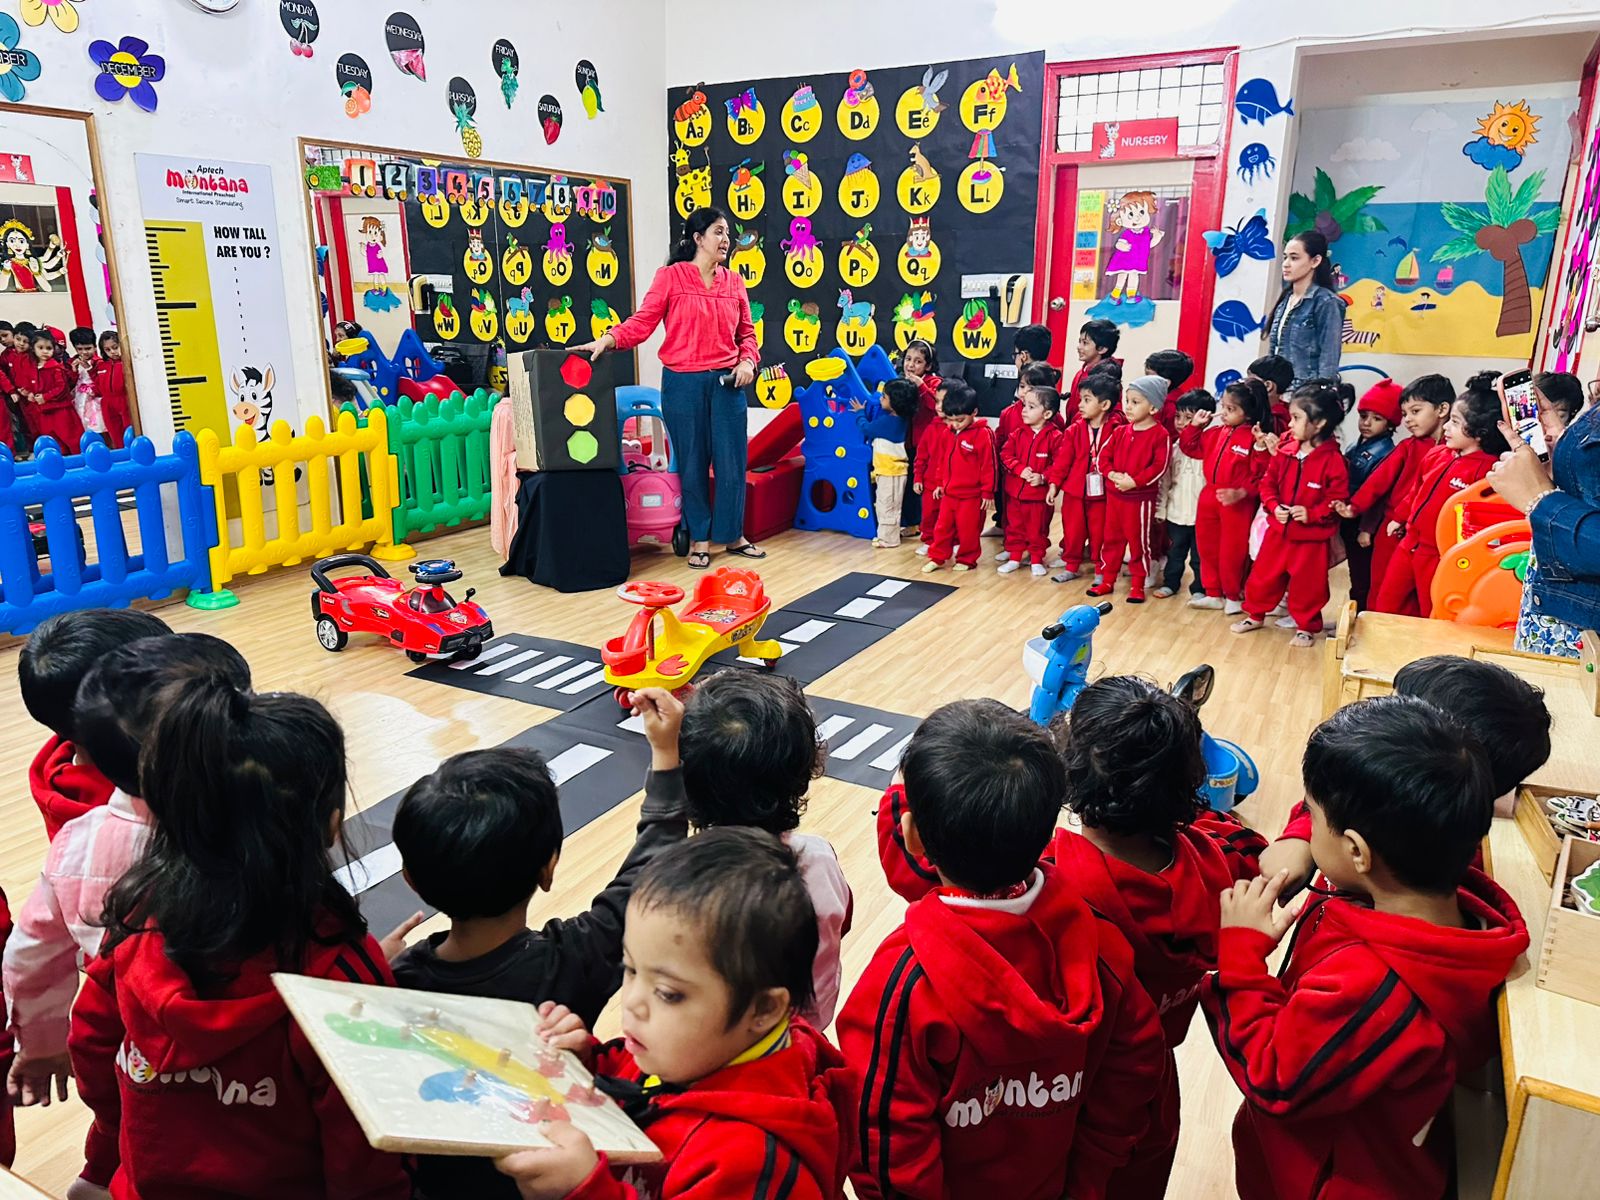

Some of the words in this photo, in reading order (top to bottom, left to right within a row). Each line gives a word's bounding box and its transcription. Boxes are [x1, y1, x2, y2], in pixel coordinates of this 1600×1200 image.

[281, 1, 314, 17] MONDAY
[0, 52, 26, 66] BER
[495, 44, 514, 57] FRIDAY
[101, 62, 156, 77] DECEMBER
[338, 62, 368, 78] TUESDAY
[577, 65, 596, 77] SUNDAY
[449, 91, 476, 103] HURSDAY
[538, 102, 562, 115] SATURDAY
[973, 104, 996, 124] Ff
[737, 118, 754, 136] Bb
[791, 115, 810, 133] Cc
[850, 111, 870, 130] Dd
[908, 110, 930, 130] Ee
[685, 121, 704, 139] Aa
[1121, 135, 1168, 147] NURSERY
[197, 165, 224, 175] Aptech
[165, 169, 249, 193] montana
[360, 165, 365, 186] 1
[392, 166, 402, 185] 2
[421, 172, 432, 190] 3
[452, 175, 463, 193] 4
[481, 181, 489, 199] 5
[508, 183, 516, 201] 6
[533, 184, 542, 202] 7
[559, 187, 565, 204] 8
[583, 191, 590, 207] 9
[602, 191, 614, 209] 10
[683, 196, 702, 213] G
[737, 194, 756, 212] Hh
[792, 191, 811, 209] Ii
[851, 190, 869, 208] Jj
[910, 187, 931, 206] Kk
[214, 226, 240, 239] HOW
[243, 227, 266, 240] TALL
[217, 246, 237, 258] ARE
[240, 246, 261, 258] YOU
[738, 263, 757, 280] Nn
[792, 261, 813, 278] Oo
[849, 259, 869, 283] Pp
[907, 258, 930, 281] Qq
[793, 330, 809, 347] Tt
[846, 331, 865, 347] Uu
[963, 331, 991, 349] Ww
[766, 386, 776, 401] X
[945, 1071, 1083, 1127] montan
